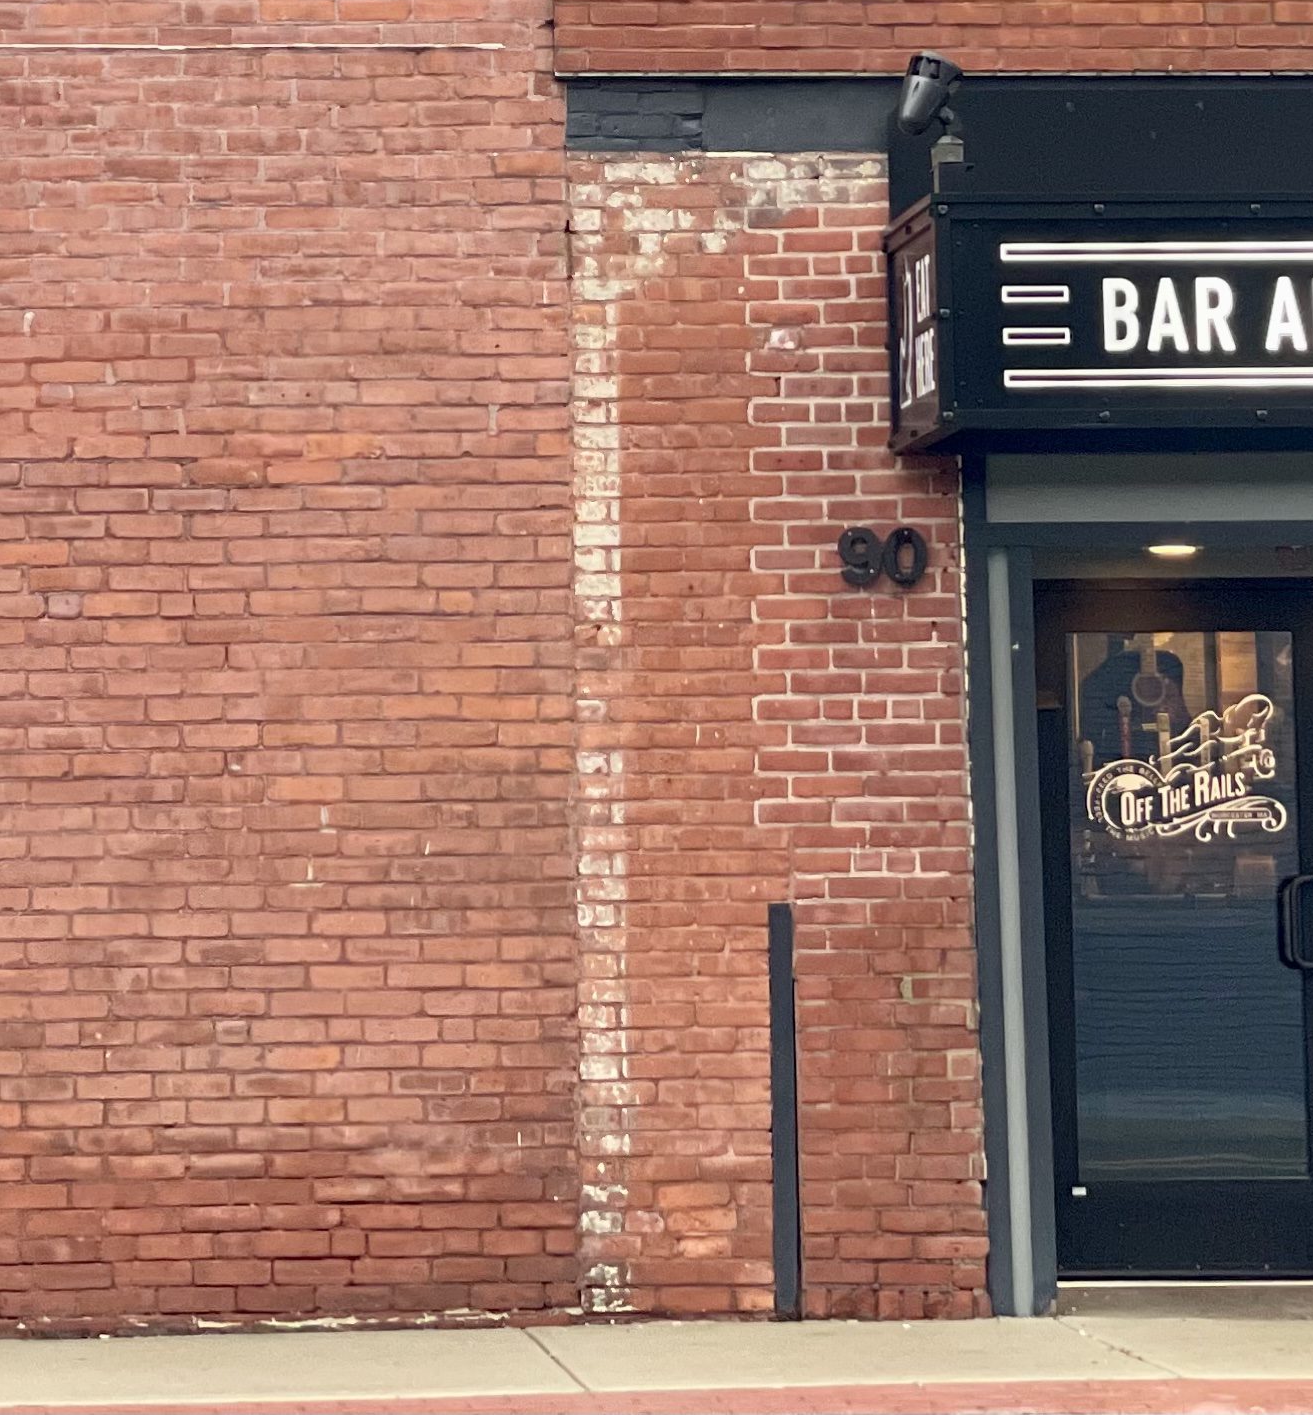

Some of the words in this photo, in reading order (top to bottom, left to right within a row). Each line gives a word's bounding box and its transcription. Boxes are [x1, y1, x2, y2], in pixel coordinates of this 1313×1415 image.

[915, 254, 930, 324] EAT
[1102, 276, 1236, 353] BAR
[915, 327, 935, 399] HERE
[838, 527, 928, 588] 90
[1121, 791, 1153, 825] OFF
[1158, 785, 1190, 817] THE
[1194, 771, 1245, 806] RAILS
